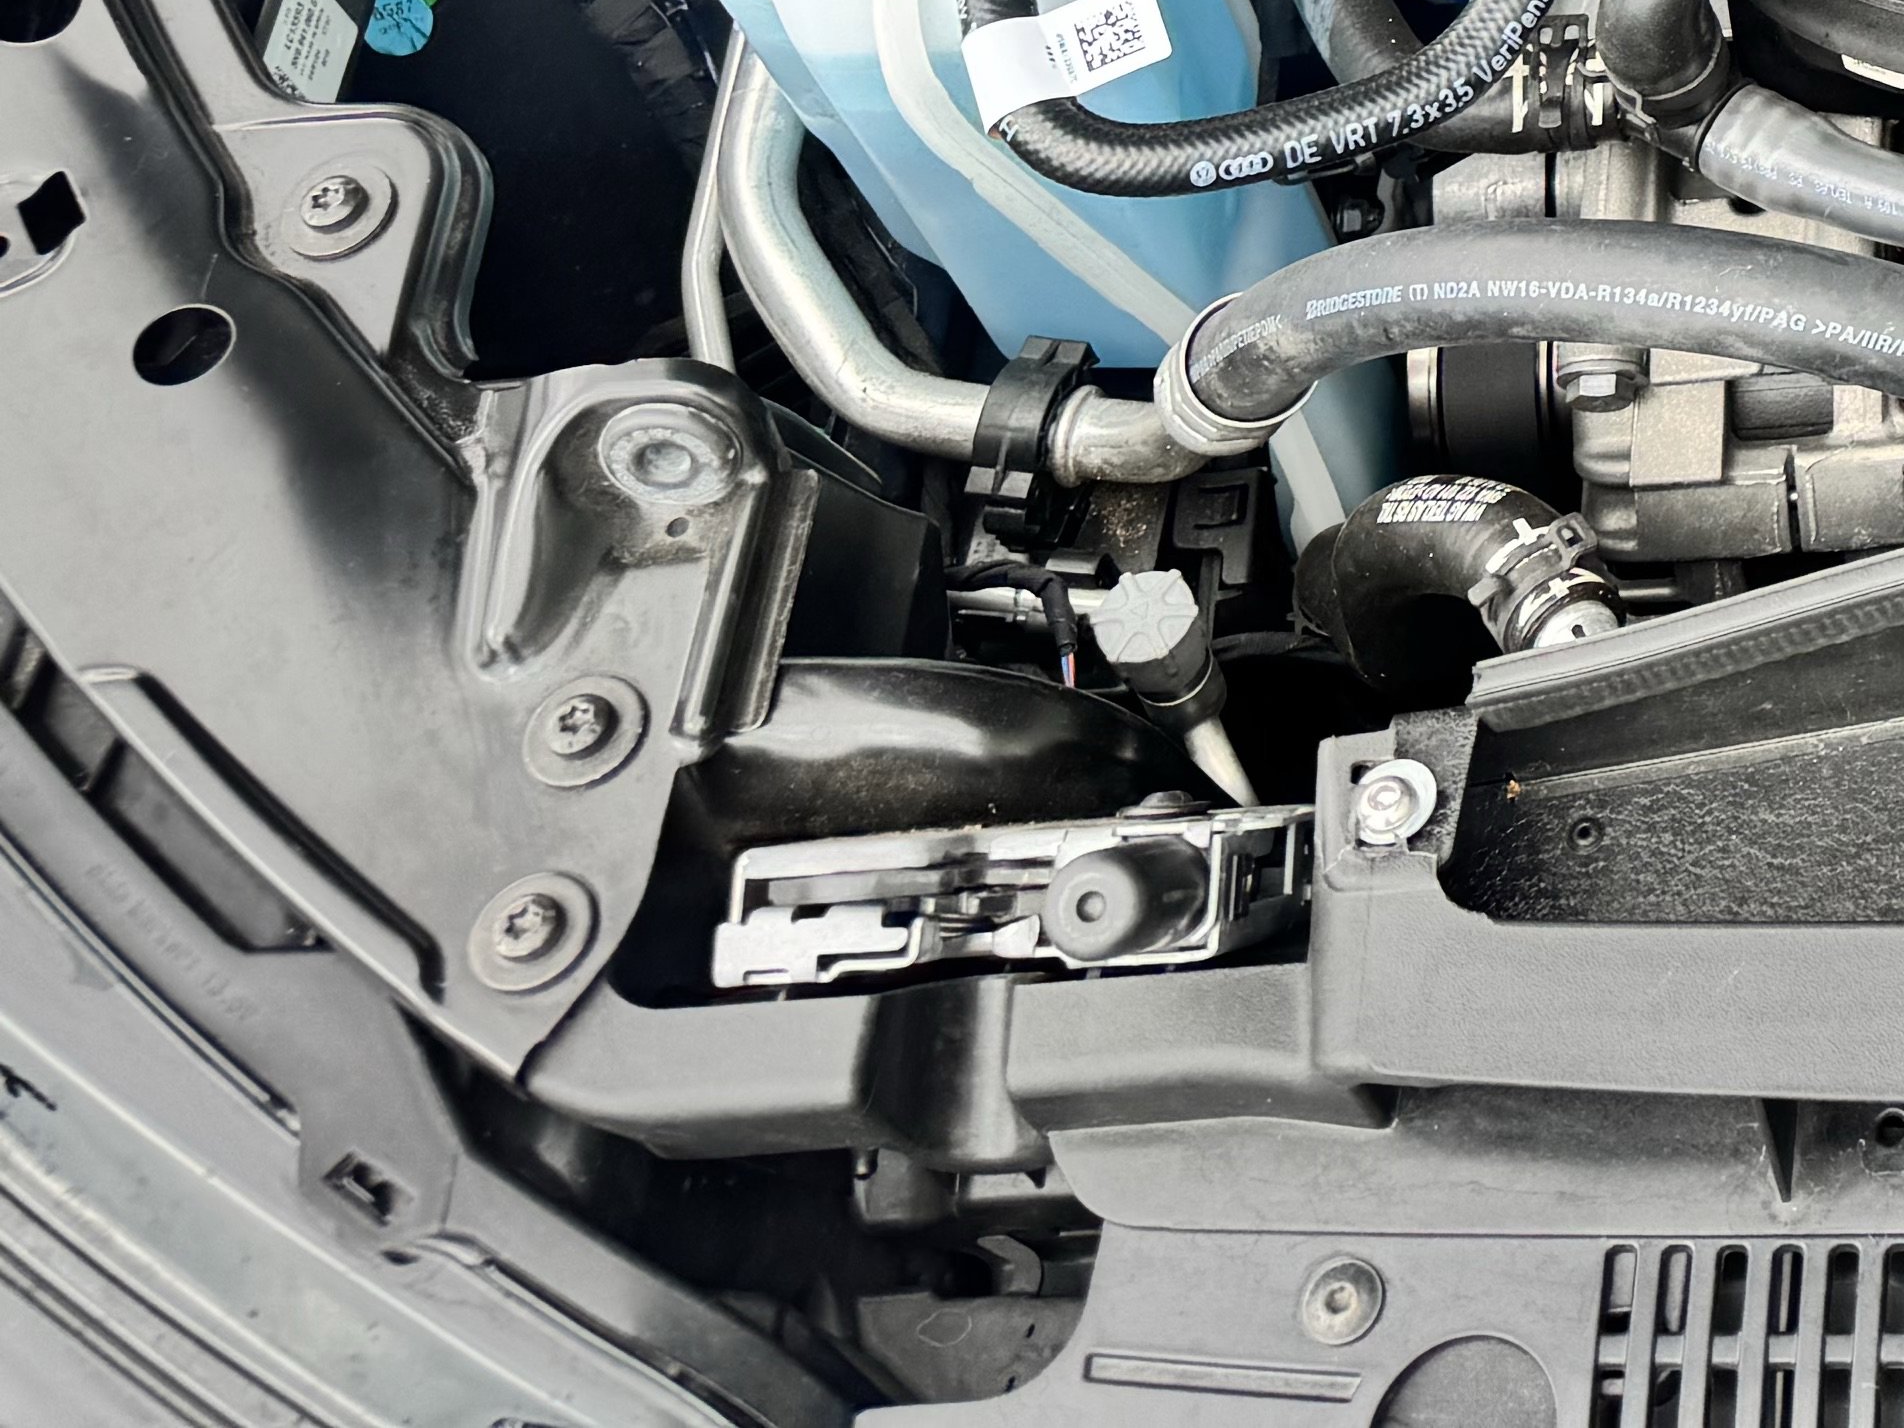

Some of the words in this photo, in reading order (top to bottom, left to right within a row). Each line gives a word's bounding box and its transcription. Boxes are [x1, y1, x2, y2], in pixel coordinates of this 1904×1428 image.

[1284, 137, 1323, 170] DE
[1329, 118, 1380, 156] VRT
[1387, 77, 1474, 139] 7.3x3.5
[1306, 285, 1403, 321] BRIDGESTONE
[1434, 281, 1480, 300] ND2A
